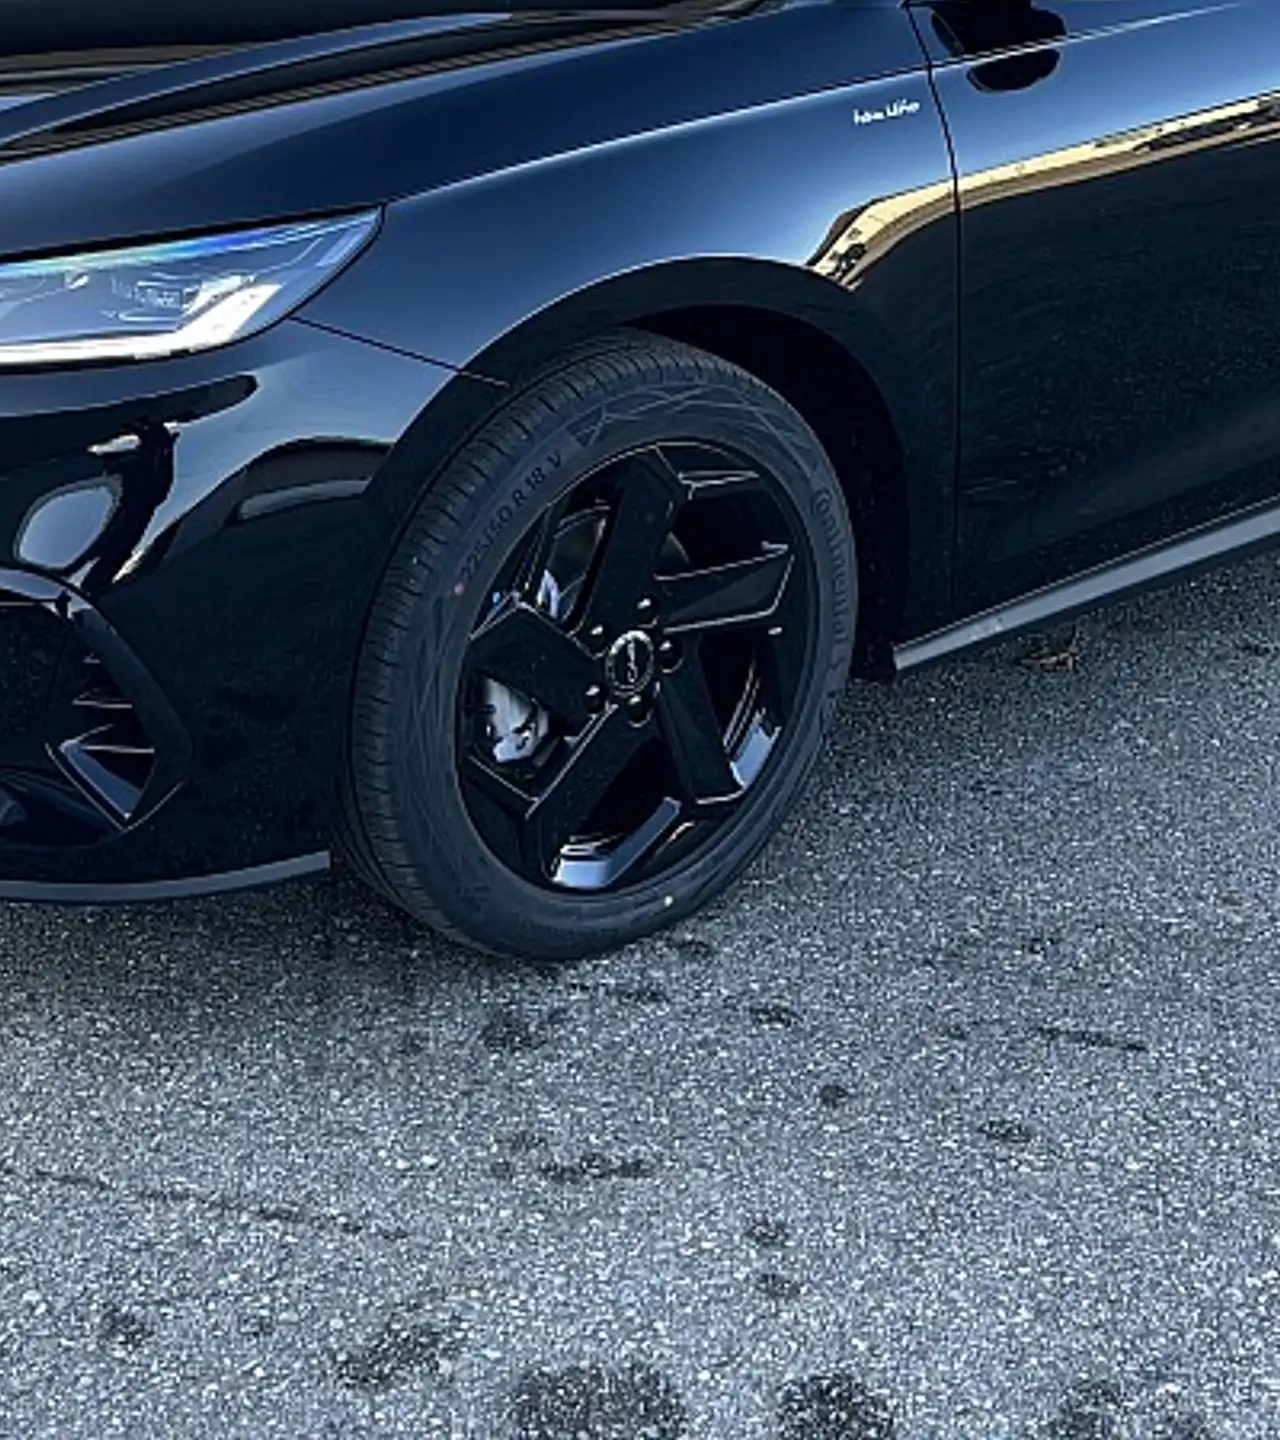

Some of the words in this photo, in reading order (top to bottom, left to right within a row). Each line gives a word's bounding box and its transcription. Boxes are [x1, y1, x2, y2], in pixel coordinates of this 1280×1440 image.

[511, 488, 529, 509] R
[523, 466, 547, 491] 18
[810, 487, 850, 645] Continental
